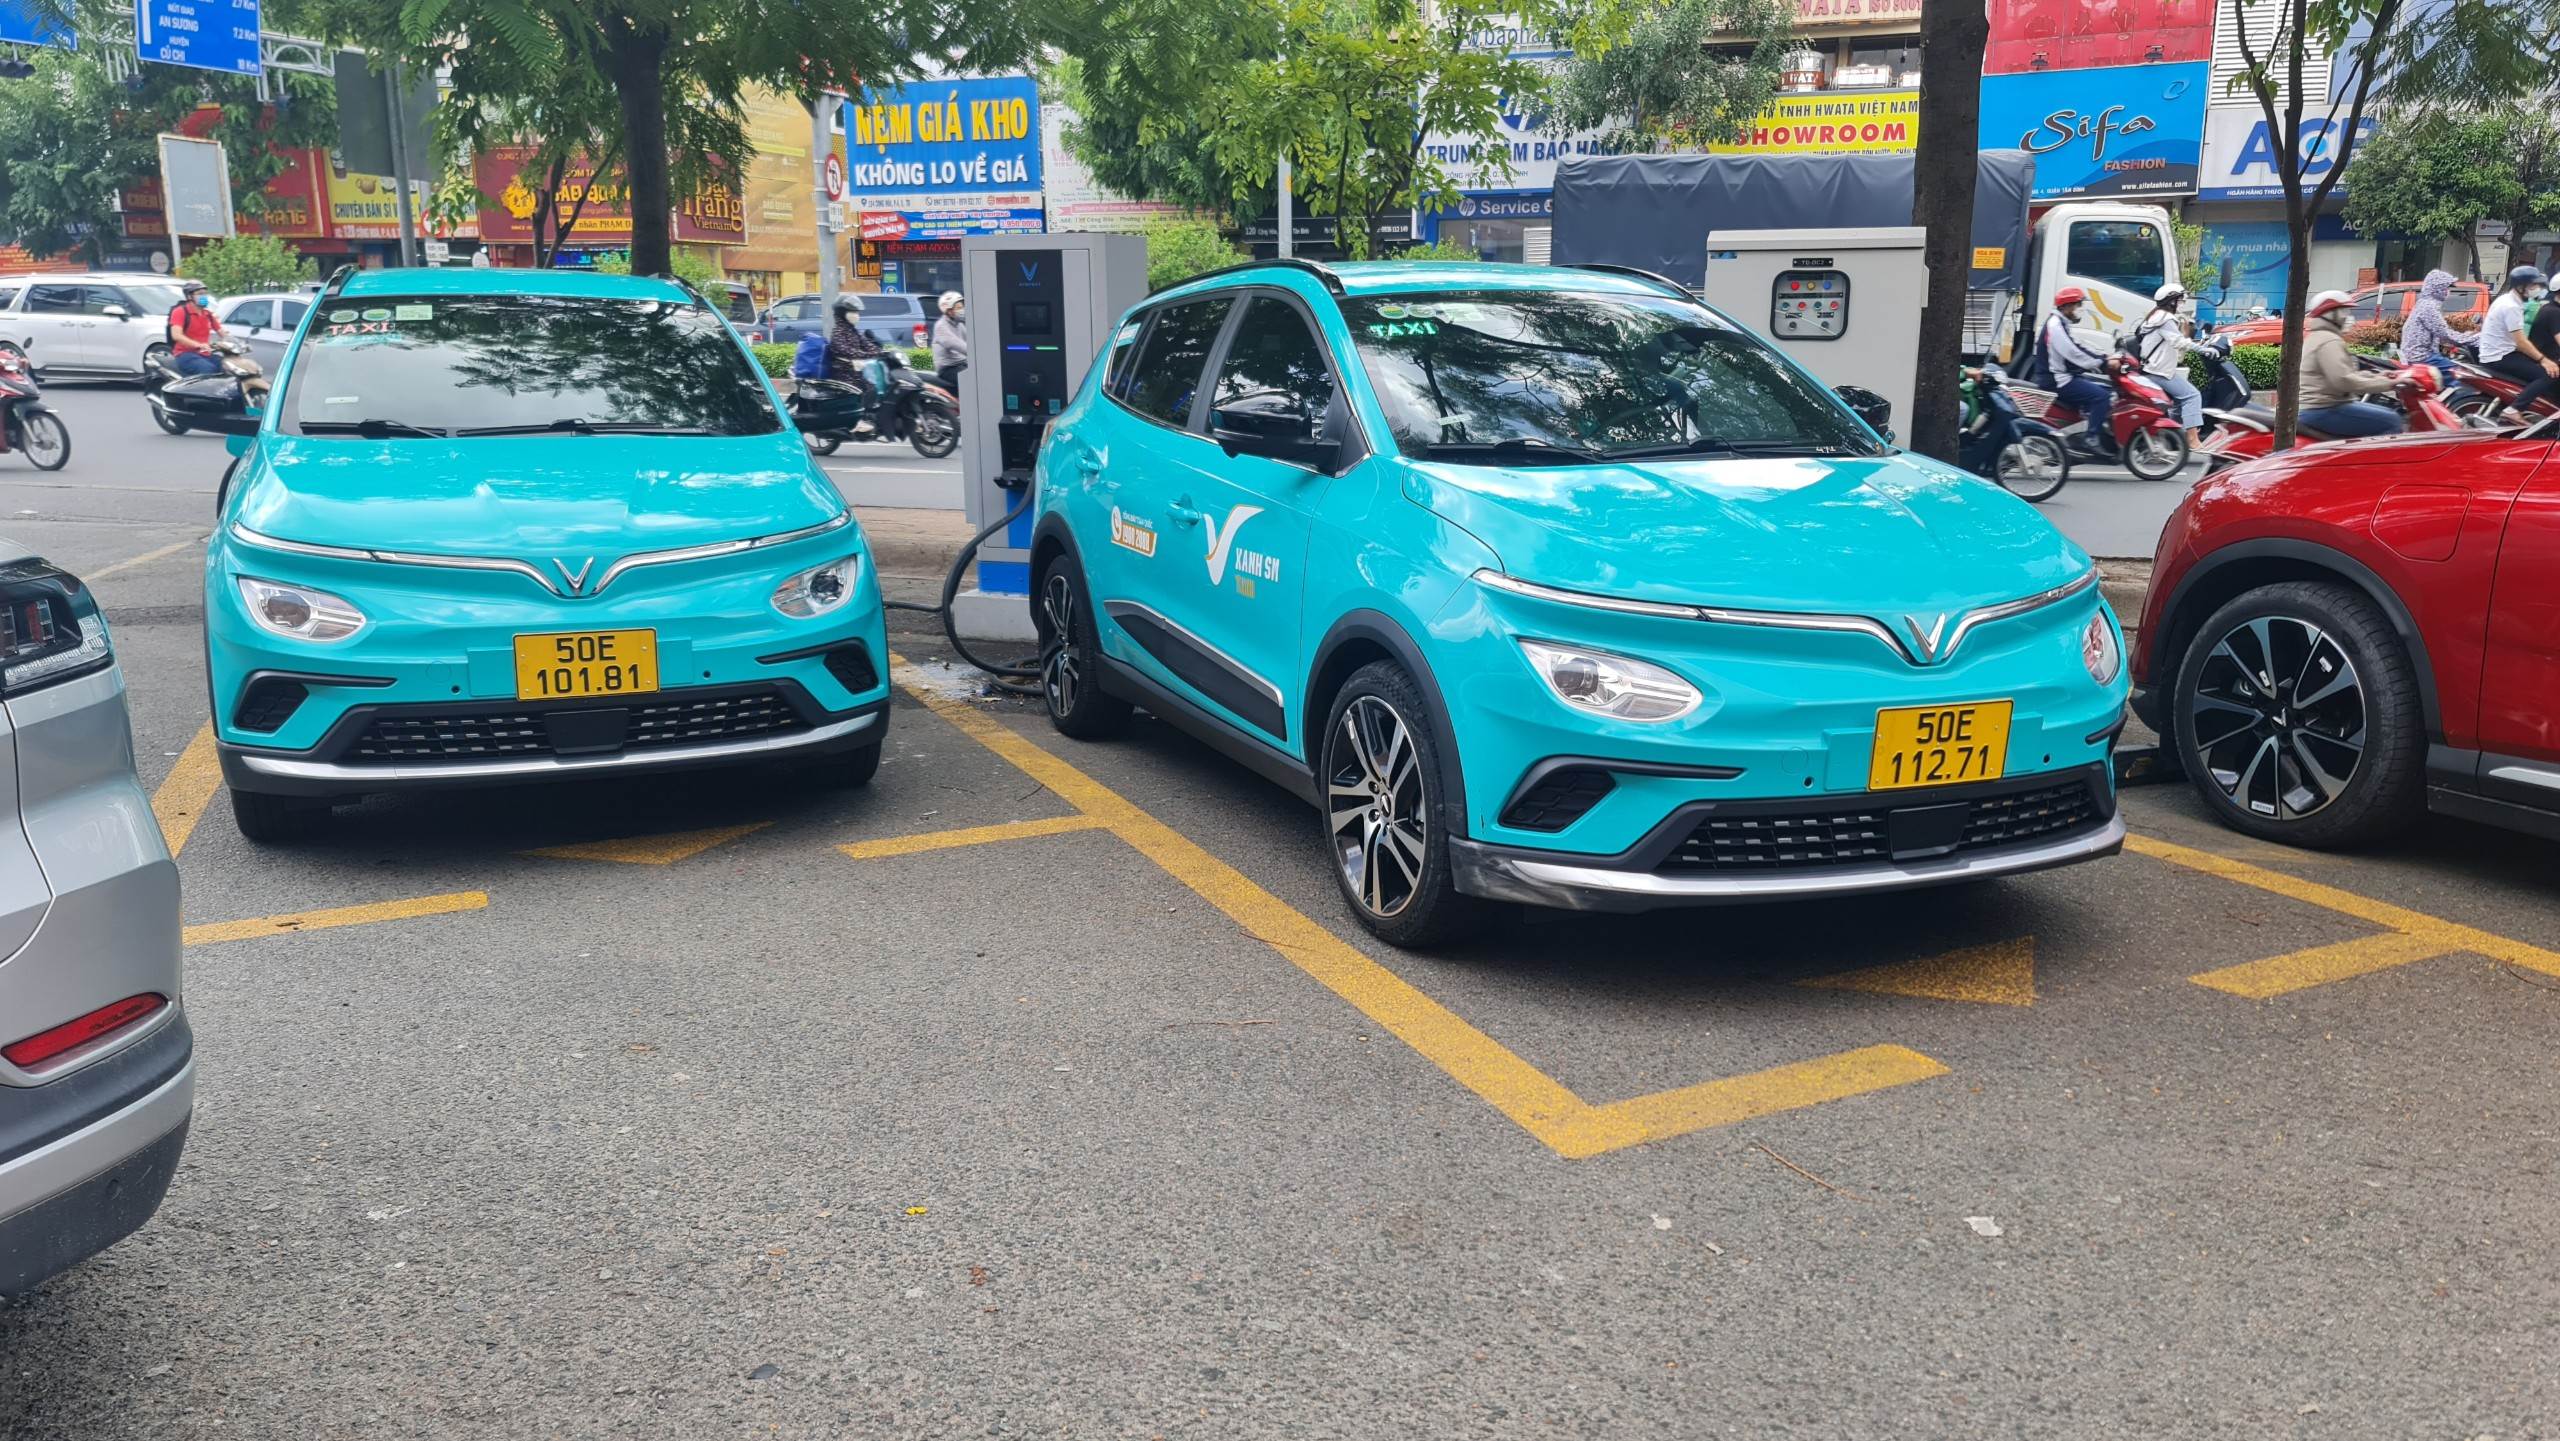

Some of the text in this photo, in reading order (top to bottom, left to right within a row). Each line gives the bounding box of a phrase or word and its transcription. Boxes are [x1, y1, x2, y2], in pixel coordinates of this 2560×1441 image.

[159, 15, 198, 32] AN SƯƠNG
[245, 30, 257, 41] Km
[172, 50, 185, 61] CHI
[246, 62, 258, 72] Km
[1780, 104, 1811, 117] TNHH
[1815, 103, 1855, 116] HWATA
[1860, 100, 1886, 117] VIỆT
[1890, 100, 1918, 113] NAM
[855, 90, 1028, 155] NỆM GIÁ KHO
[1736, 122, 1906, 148] SHOWROOM
[2019, 105, 2155, 161] Sifa
[855, 158, 924, 186] KHÔNG
[930, 160, 956, 184] LO
[960, 152, 987, 183] VỀ
[992, 154, 1028, 183] GIÁ
[2104, 158, 2166, 172] FASHION
[335, 201, 363, 218] CHUYÊN
[1481, 199, 1540, 215] Service
[694, 216, 732, 232] Vietnam
[2237, 244, 2262, 252] mua
[2266, 240, 2288, 252] nhà
[329, 322, 389, 336] TAXI
[1369, 321, 1436, 337] TAXI
[1235, 547, 1280, 583] XANH SM
[556, 635, 616, 663] 50E
[537, 664, 639, 695] 101.81
[1916, 709, 1975, 744] 50E
[1892, 745, 1989, 783] 112.71
